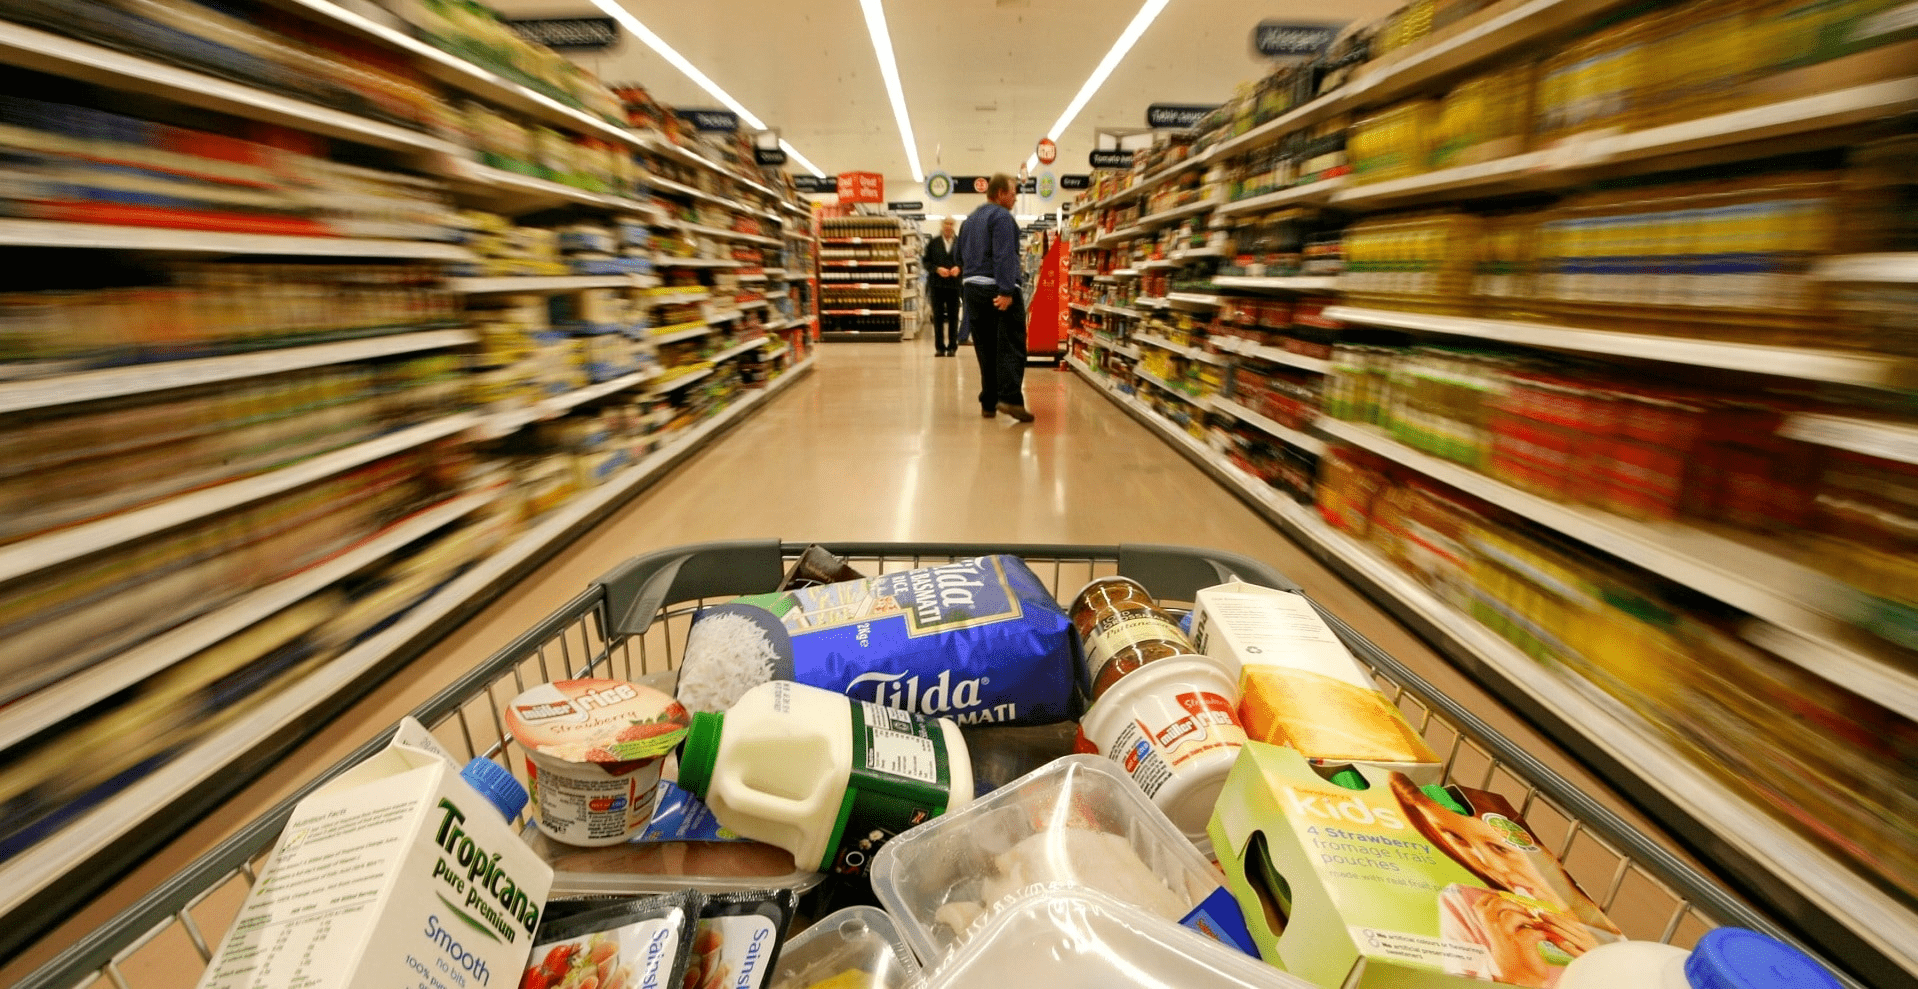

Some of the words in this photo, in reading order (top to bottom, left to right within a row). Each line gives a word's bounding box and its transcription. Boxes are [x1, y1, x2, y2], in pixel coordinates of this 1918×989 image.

[890, 574, 909, 598] RICE
[910, 571, 942, 625] BASMATI
[576, 684, 637, 711] rice
[845, 668, 984, 716] Tilda
[550, 710, 638, 734] Strawberry
[1283, 786, 1405, 831] kids
[1307, 825, 1320, 835] 4
[1325, 827, 1431, 854] Strawberry
[1313, 837, 1392, 859] fromage
[1395, 848, 1437, 866] frais
[435, 797, 540, 935] Tropicana
[1321, 853, 1401, 872] pouches
[432, 857, 465, 894] pure
[465, 886, 516, 944] premium
[424, 914, 490, 987] Smooth
[406, 955, 430, 979] 100%
[436, 958, 450, 973] no
[450, 967, 466, 989] bits
